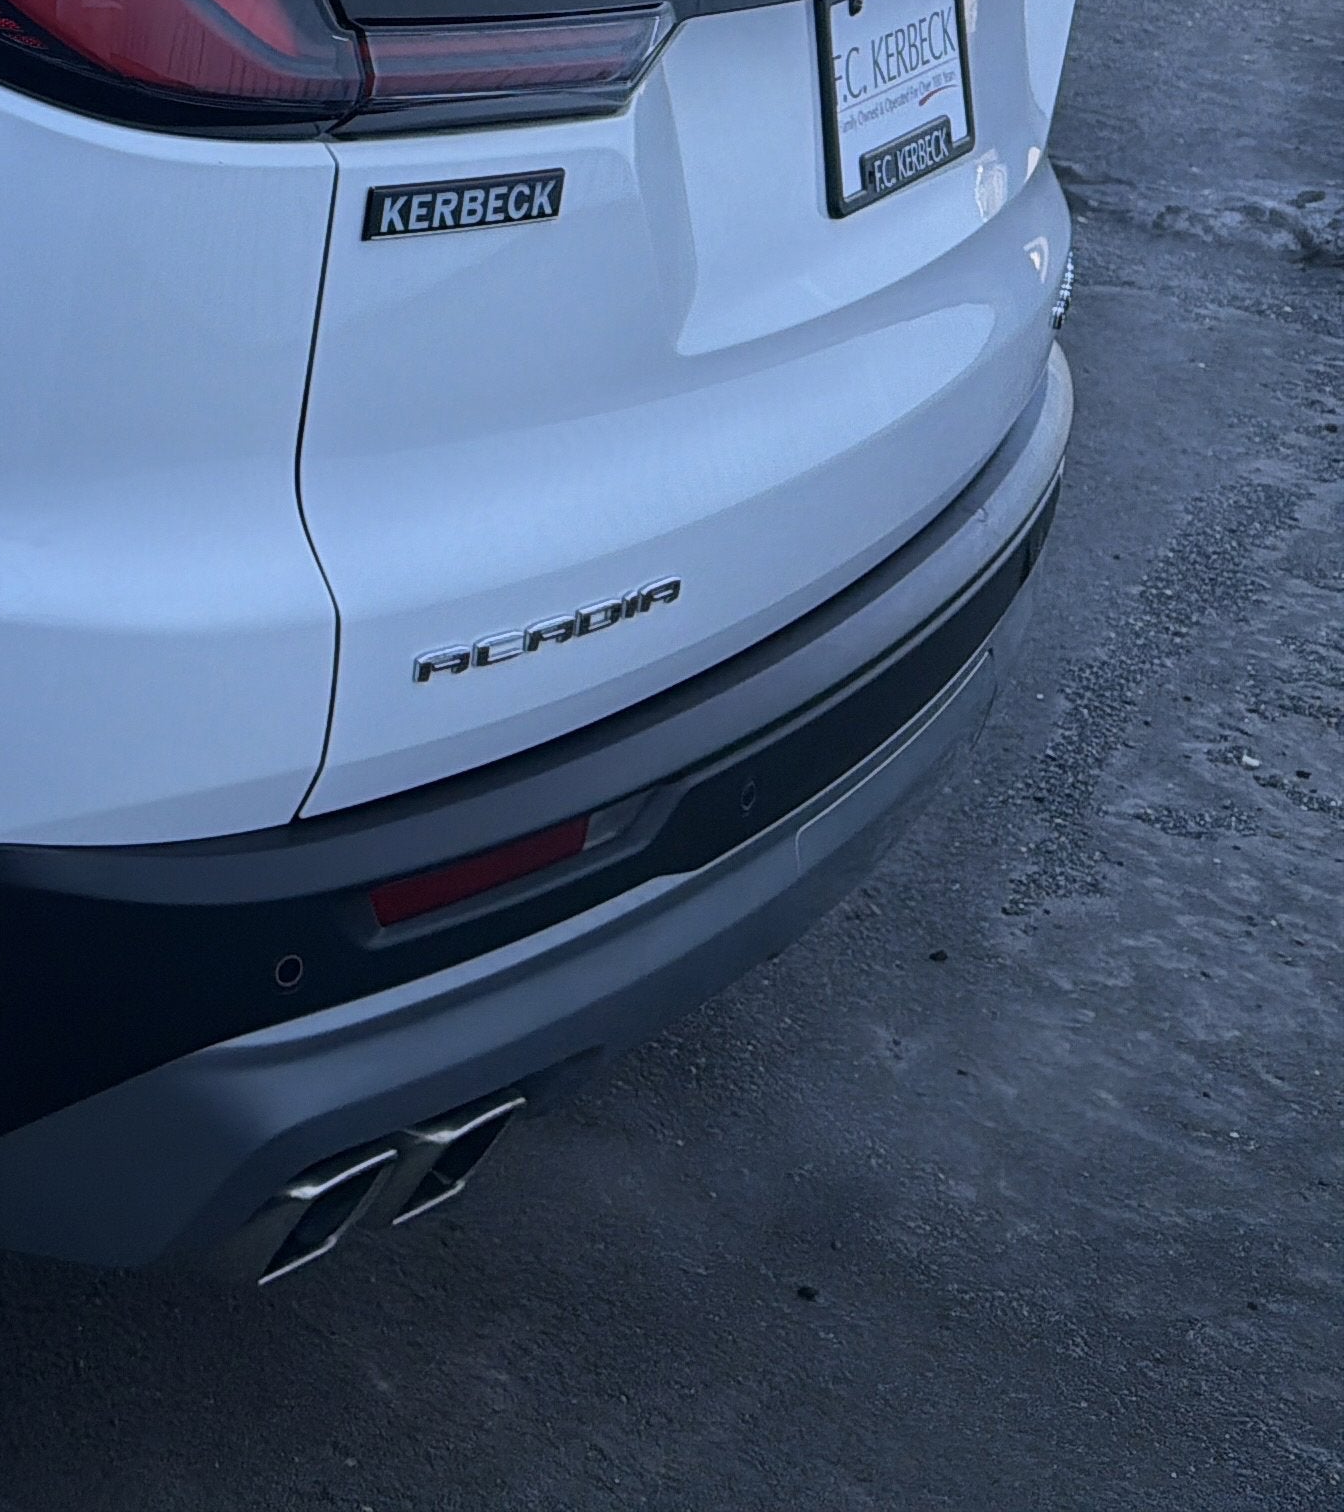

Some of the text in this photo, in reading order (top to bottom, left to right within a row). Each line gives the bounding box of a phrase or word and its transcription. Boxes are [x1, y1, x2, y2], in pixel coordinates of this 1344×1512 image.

[871, 6, 956, 88] KERBECK
[873, 127, 949, 193] F.C. KERBECK
[379, 179, 556, 234] KERBECK
[412, 575, 682, 683] ACADIA
